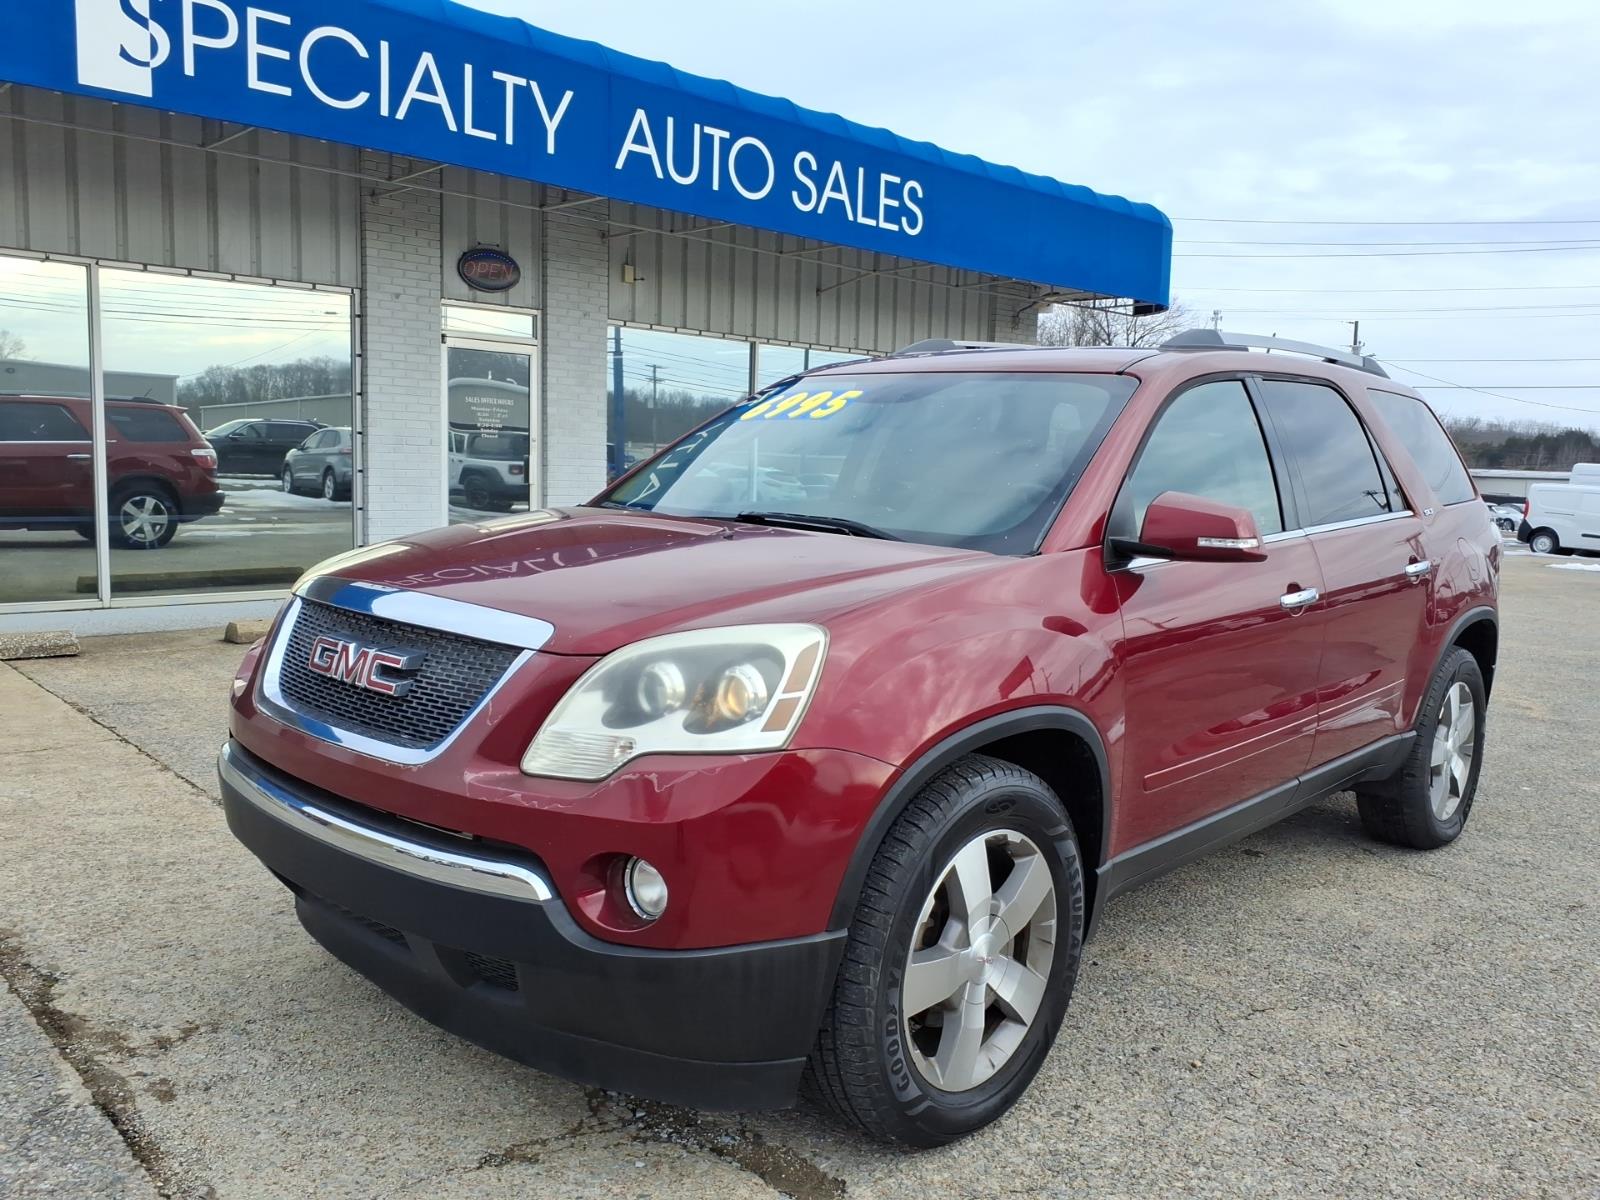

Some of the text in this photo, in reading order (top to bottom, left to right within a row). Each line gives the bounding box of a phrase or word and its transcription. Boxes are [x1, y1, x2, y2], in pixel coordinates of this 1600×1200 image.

[117, 0, 924, 236] SPECIALTY AUTO SALES
[464, 261, 515, 280] OPEN
[308, 634, 410, 697] GMC
